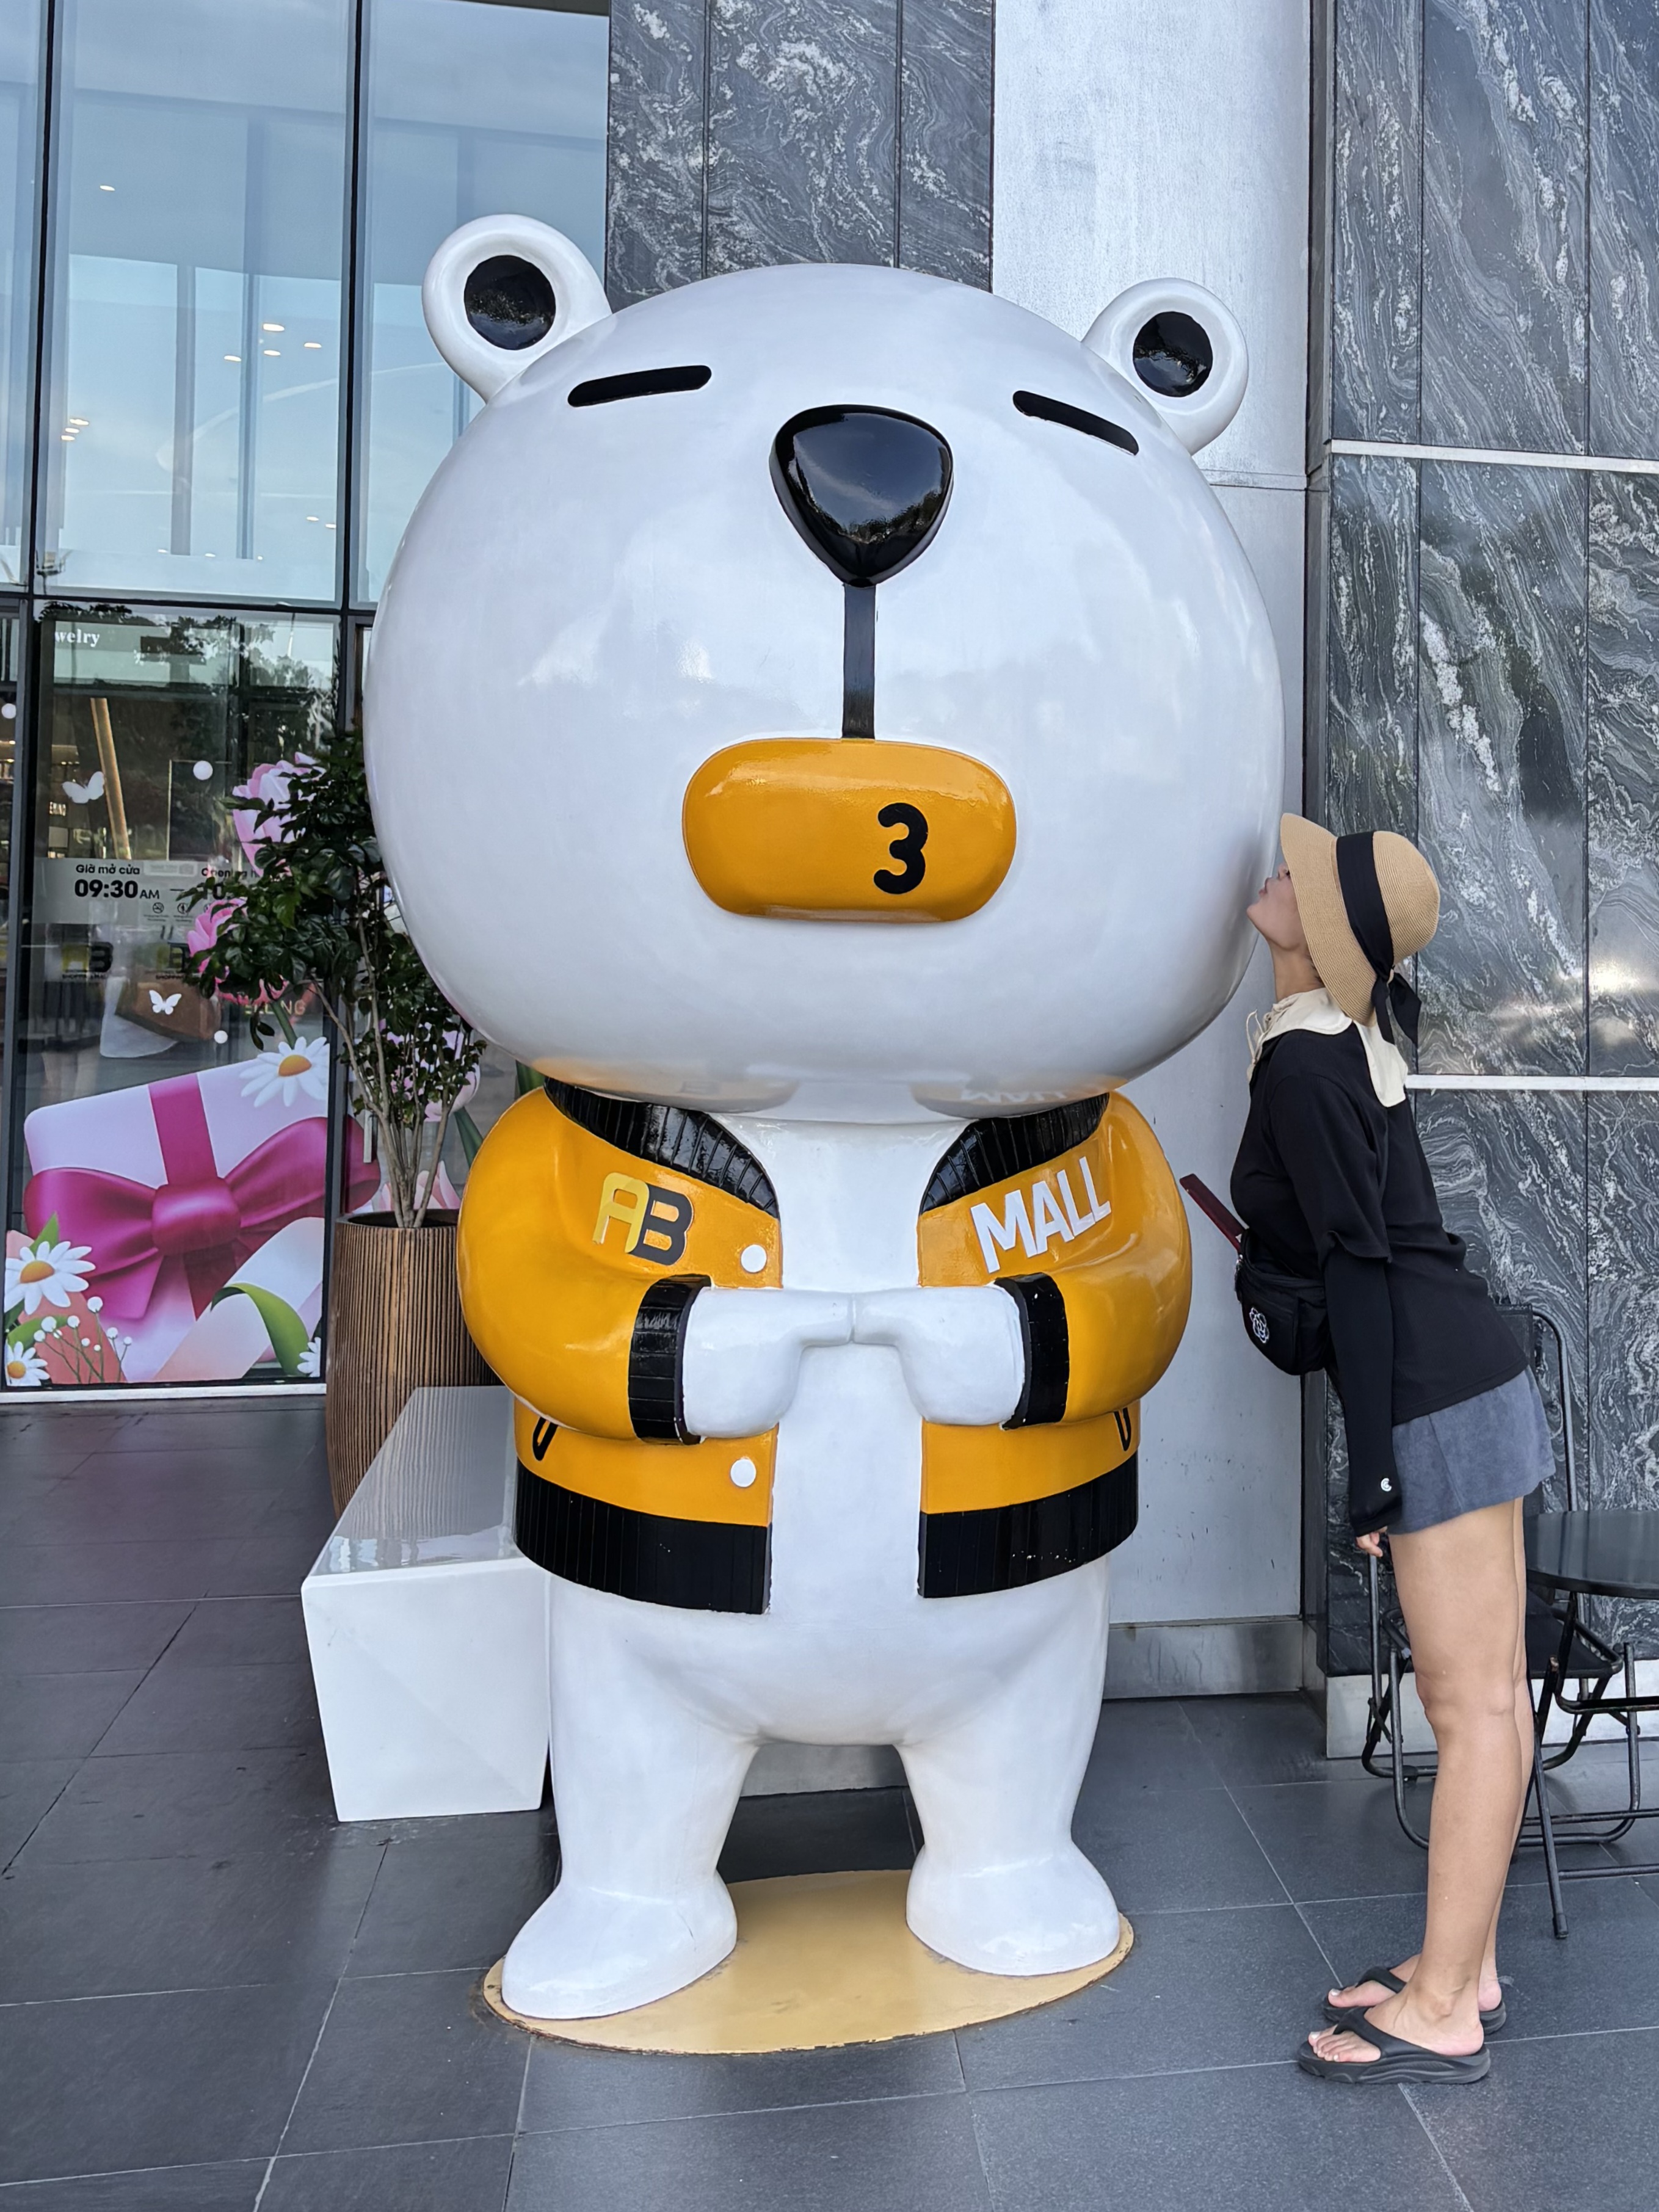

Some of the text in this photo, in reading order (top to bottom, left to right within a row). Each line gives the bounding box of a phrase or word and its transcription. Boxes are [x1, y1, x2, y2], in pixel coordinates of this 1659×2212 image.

[74, 879, 159, 899] 09:30 AM
[76, 865, 95, 874] Giờ
[98, 863, 116, 874] mở
[119, 864, 140, 874] cửa
[873, 802, 928, 894] 3
[592, 1172, 697, 1266] AB
[970, 1156, 1112, 1274] MALL
